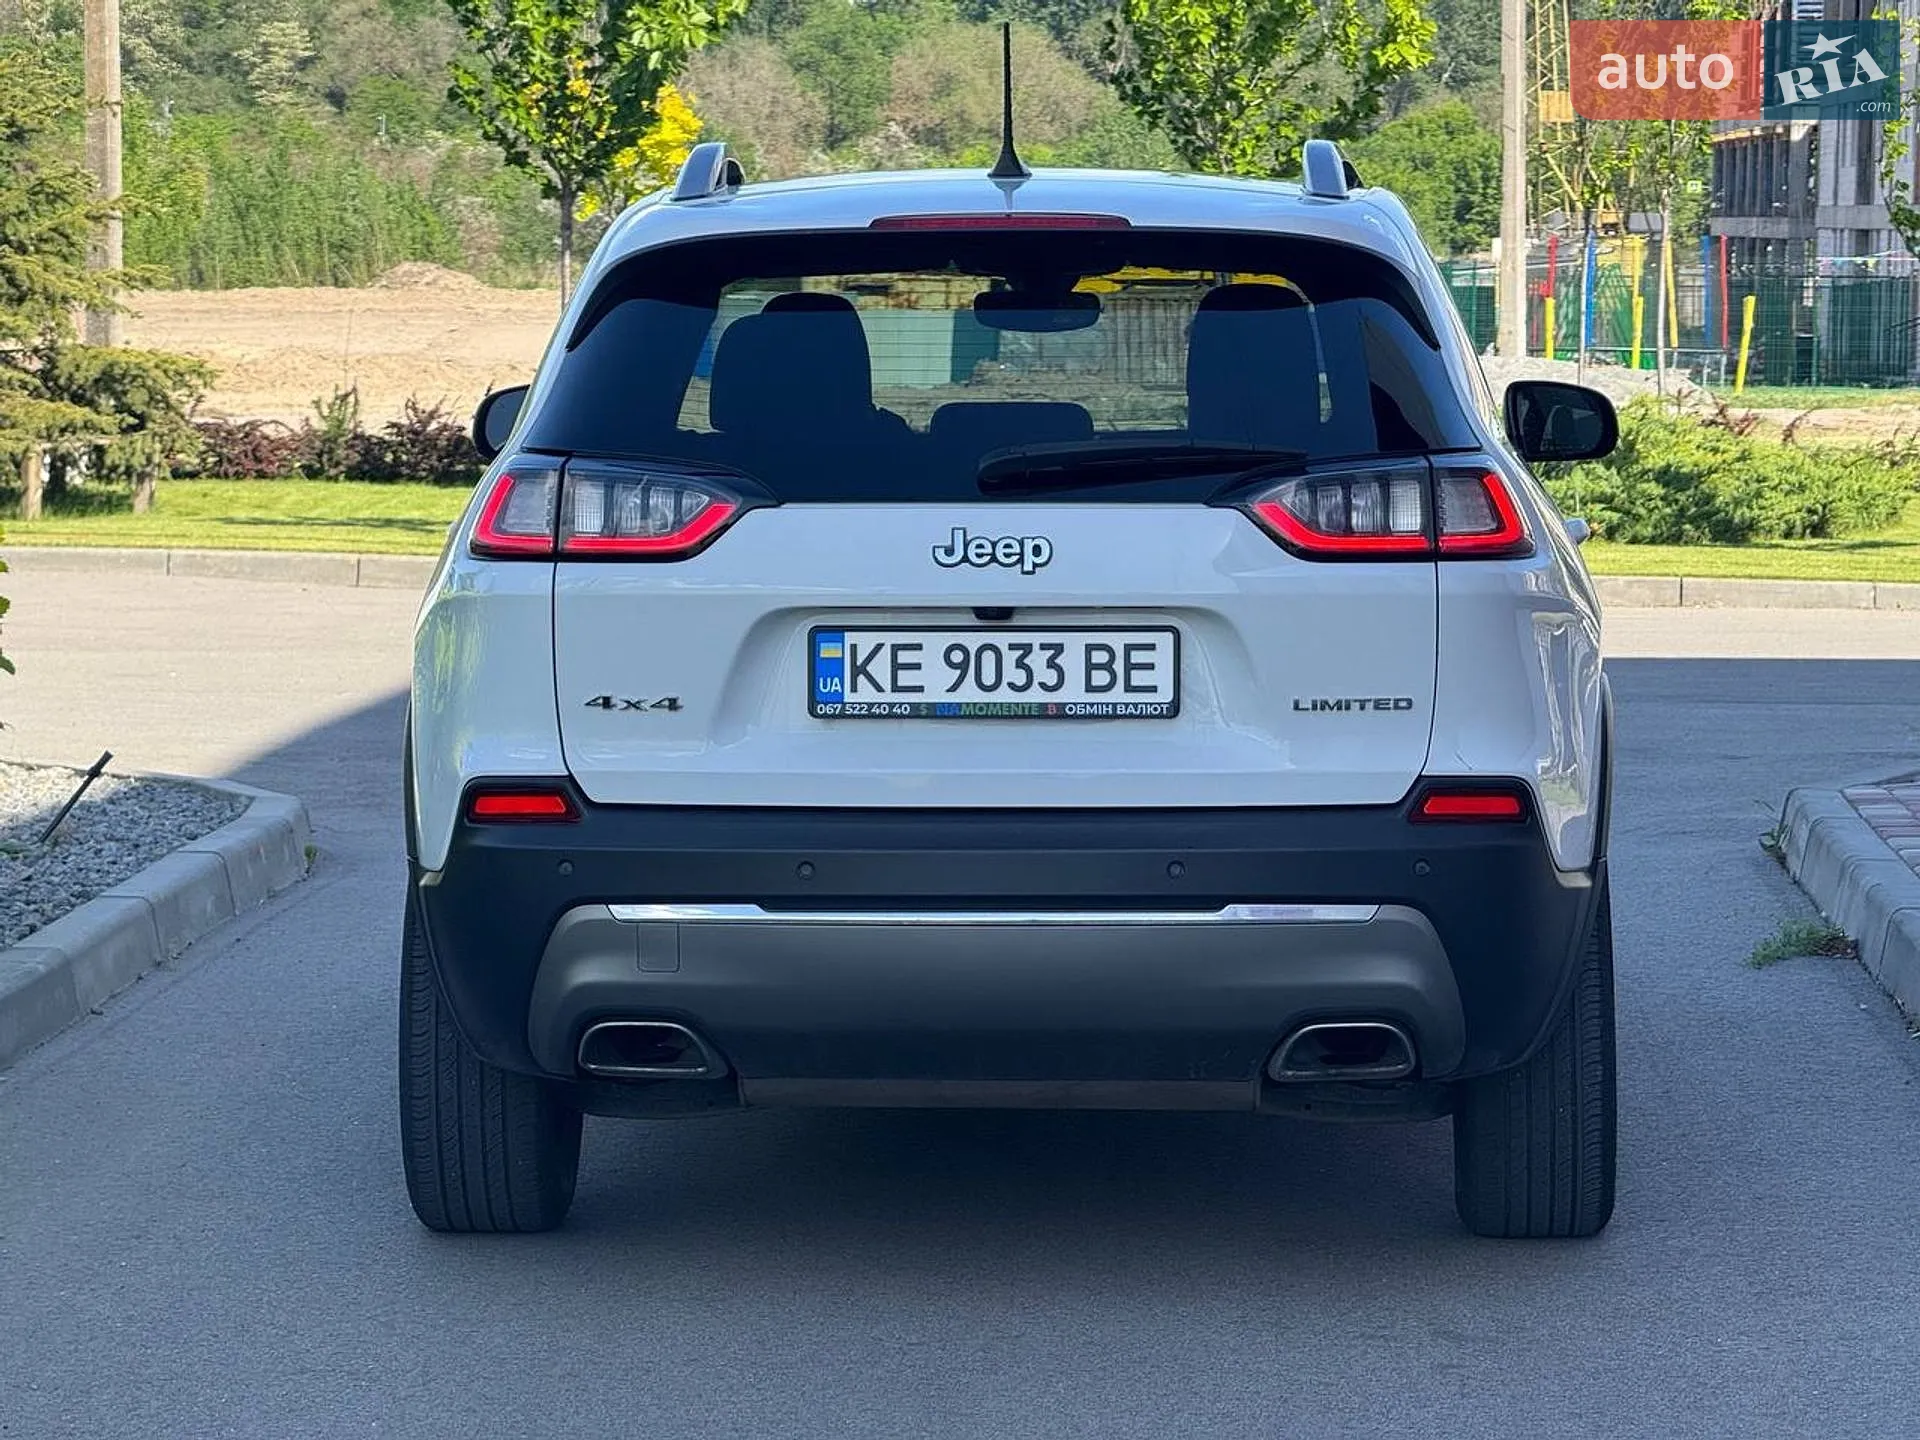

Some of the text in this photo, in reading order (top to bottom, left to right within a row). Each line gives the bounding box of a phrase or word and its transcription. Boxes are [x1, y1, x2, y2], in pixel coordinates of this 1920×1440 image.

[932, 527, 1053, 575] Jeep
[849, 643, 1158, 693] KE 9033 BE
[819, 677, 842, 693] UA
[583, 695, 684, 712] 4x4
[817, 703, 841, 715] 067
[844, 703, 869, 715] 522
[871, 703, 889, 715] 40
[892, 703, 911, 715] 40
[1065, 702, 1112, 715] ОБМІН
[1116, 703, 1169, 715] ВАЛЮТ
[1293, 698, 1413, 712] LIMITED
